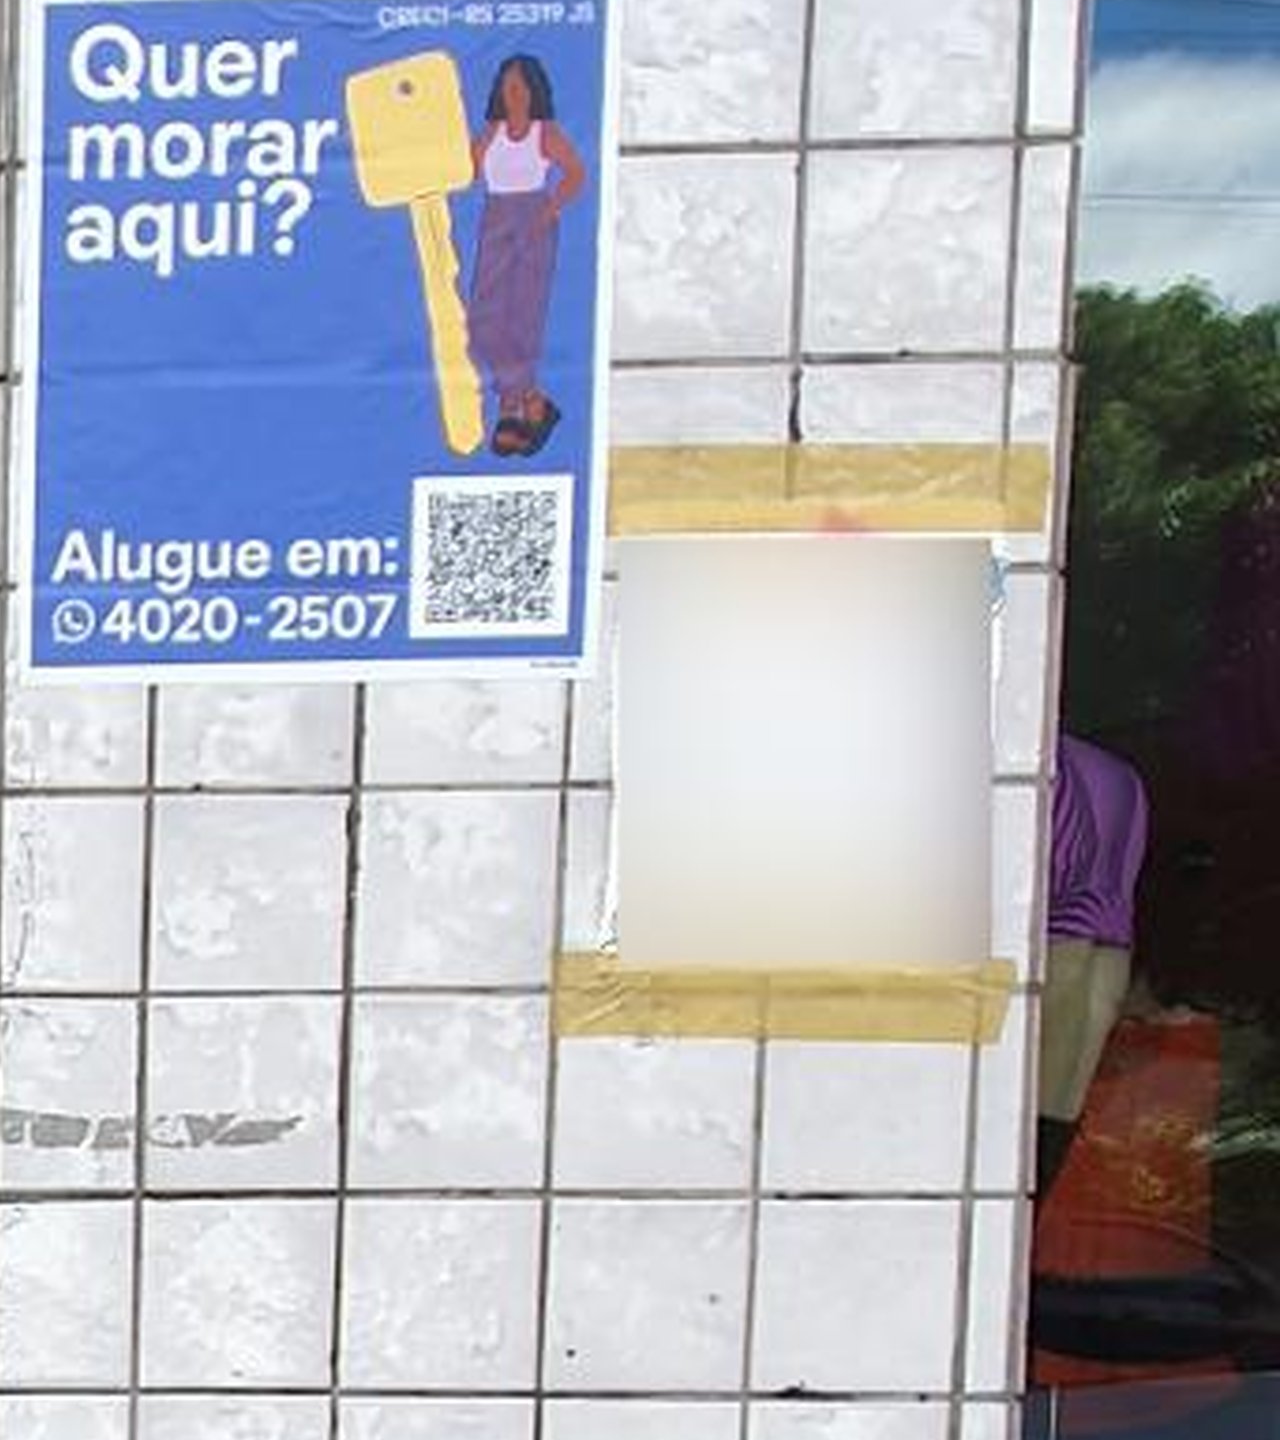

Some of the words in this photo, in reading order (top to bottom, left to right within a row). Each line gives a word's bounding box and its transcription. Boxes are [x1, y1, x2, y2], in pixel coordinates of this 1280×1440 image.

[70, 23, 298, 102] Quer
[68, 119, 338, 180] morar
[66, 179, 312, 277] aqui?
[51, 529, 271, 593] Alugue
[287, 537, 399, 576] em:
[102, 594, 397, 642] 4020-2507
